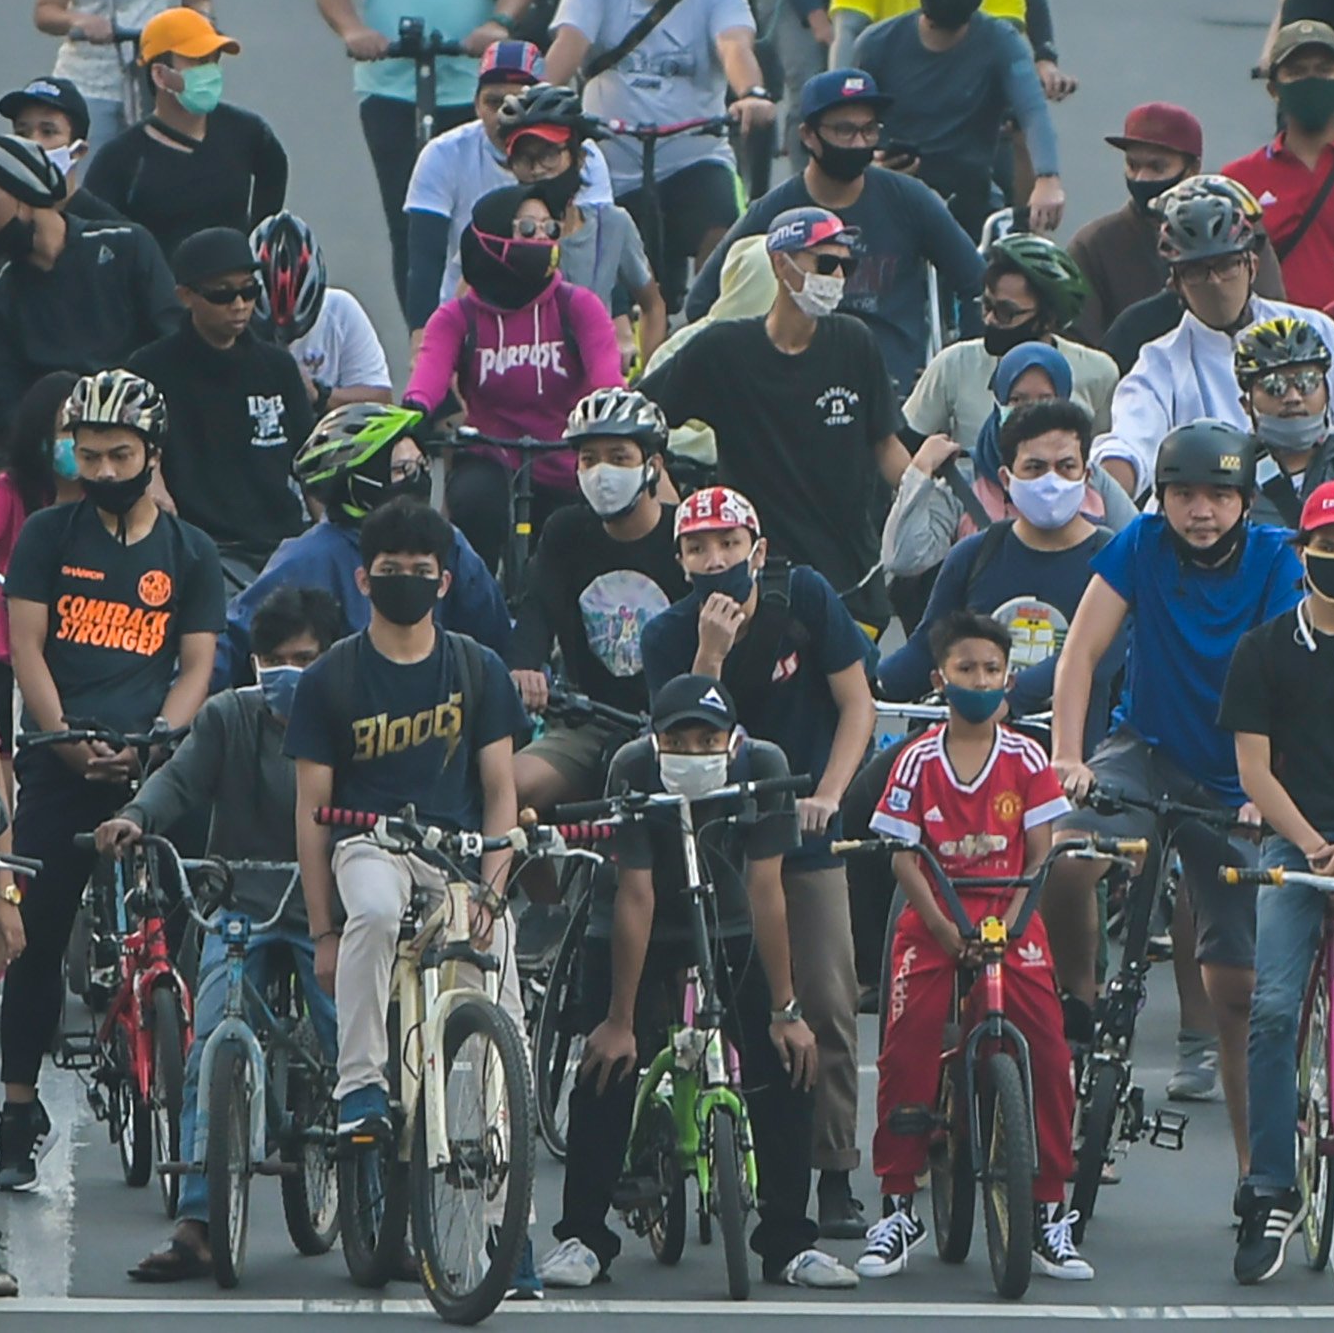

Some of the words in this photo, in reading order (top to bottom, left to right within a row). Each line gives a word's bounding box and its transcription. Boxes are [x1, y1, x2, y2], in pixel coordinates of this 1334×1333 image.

[476, 341, 568, 387] PURPOSE
[56, 594, 171, 636] COMEBACK
[56, 617, 165, 657] STRONGER
